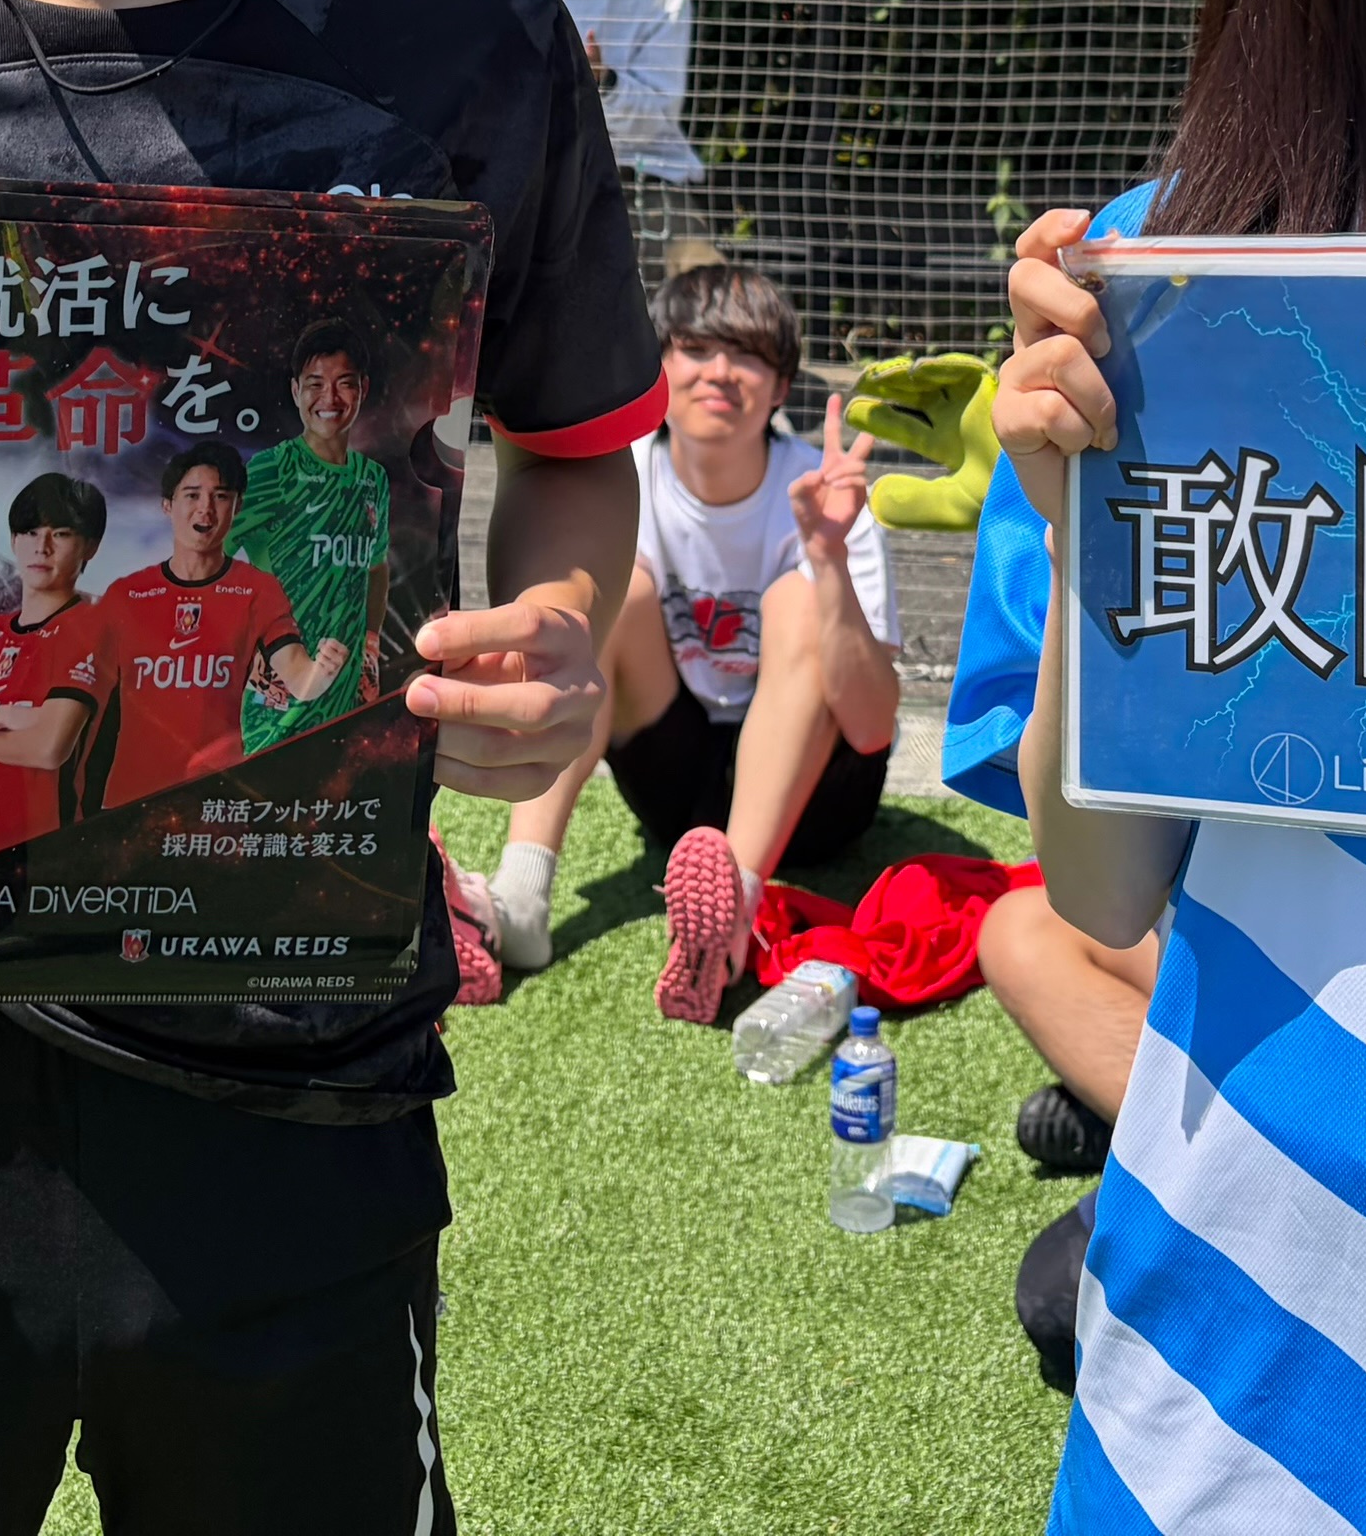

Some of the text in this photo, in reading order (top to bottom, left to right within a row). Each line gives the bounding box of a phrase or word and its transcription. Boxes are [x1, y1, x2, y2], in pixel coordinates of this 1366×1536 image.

[133, 654, 235, 690] POLUS
[200, 797, 382, 823] 就活フットサルで
[161, 832, 378, 857] 採用の常識を変える
[160, 936, 351, 957] URAWA REDS
[316, 975, 356, 988] REDS
